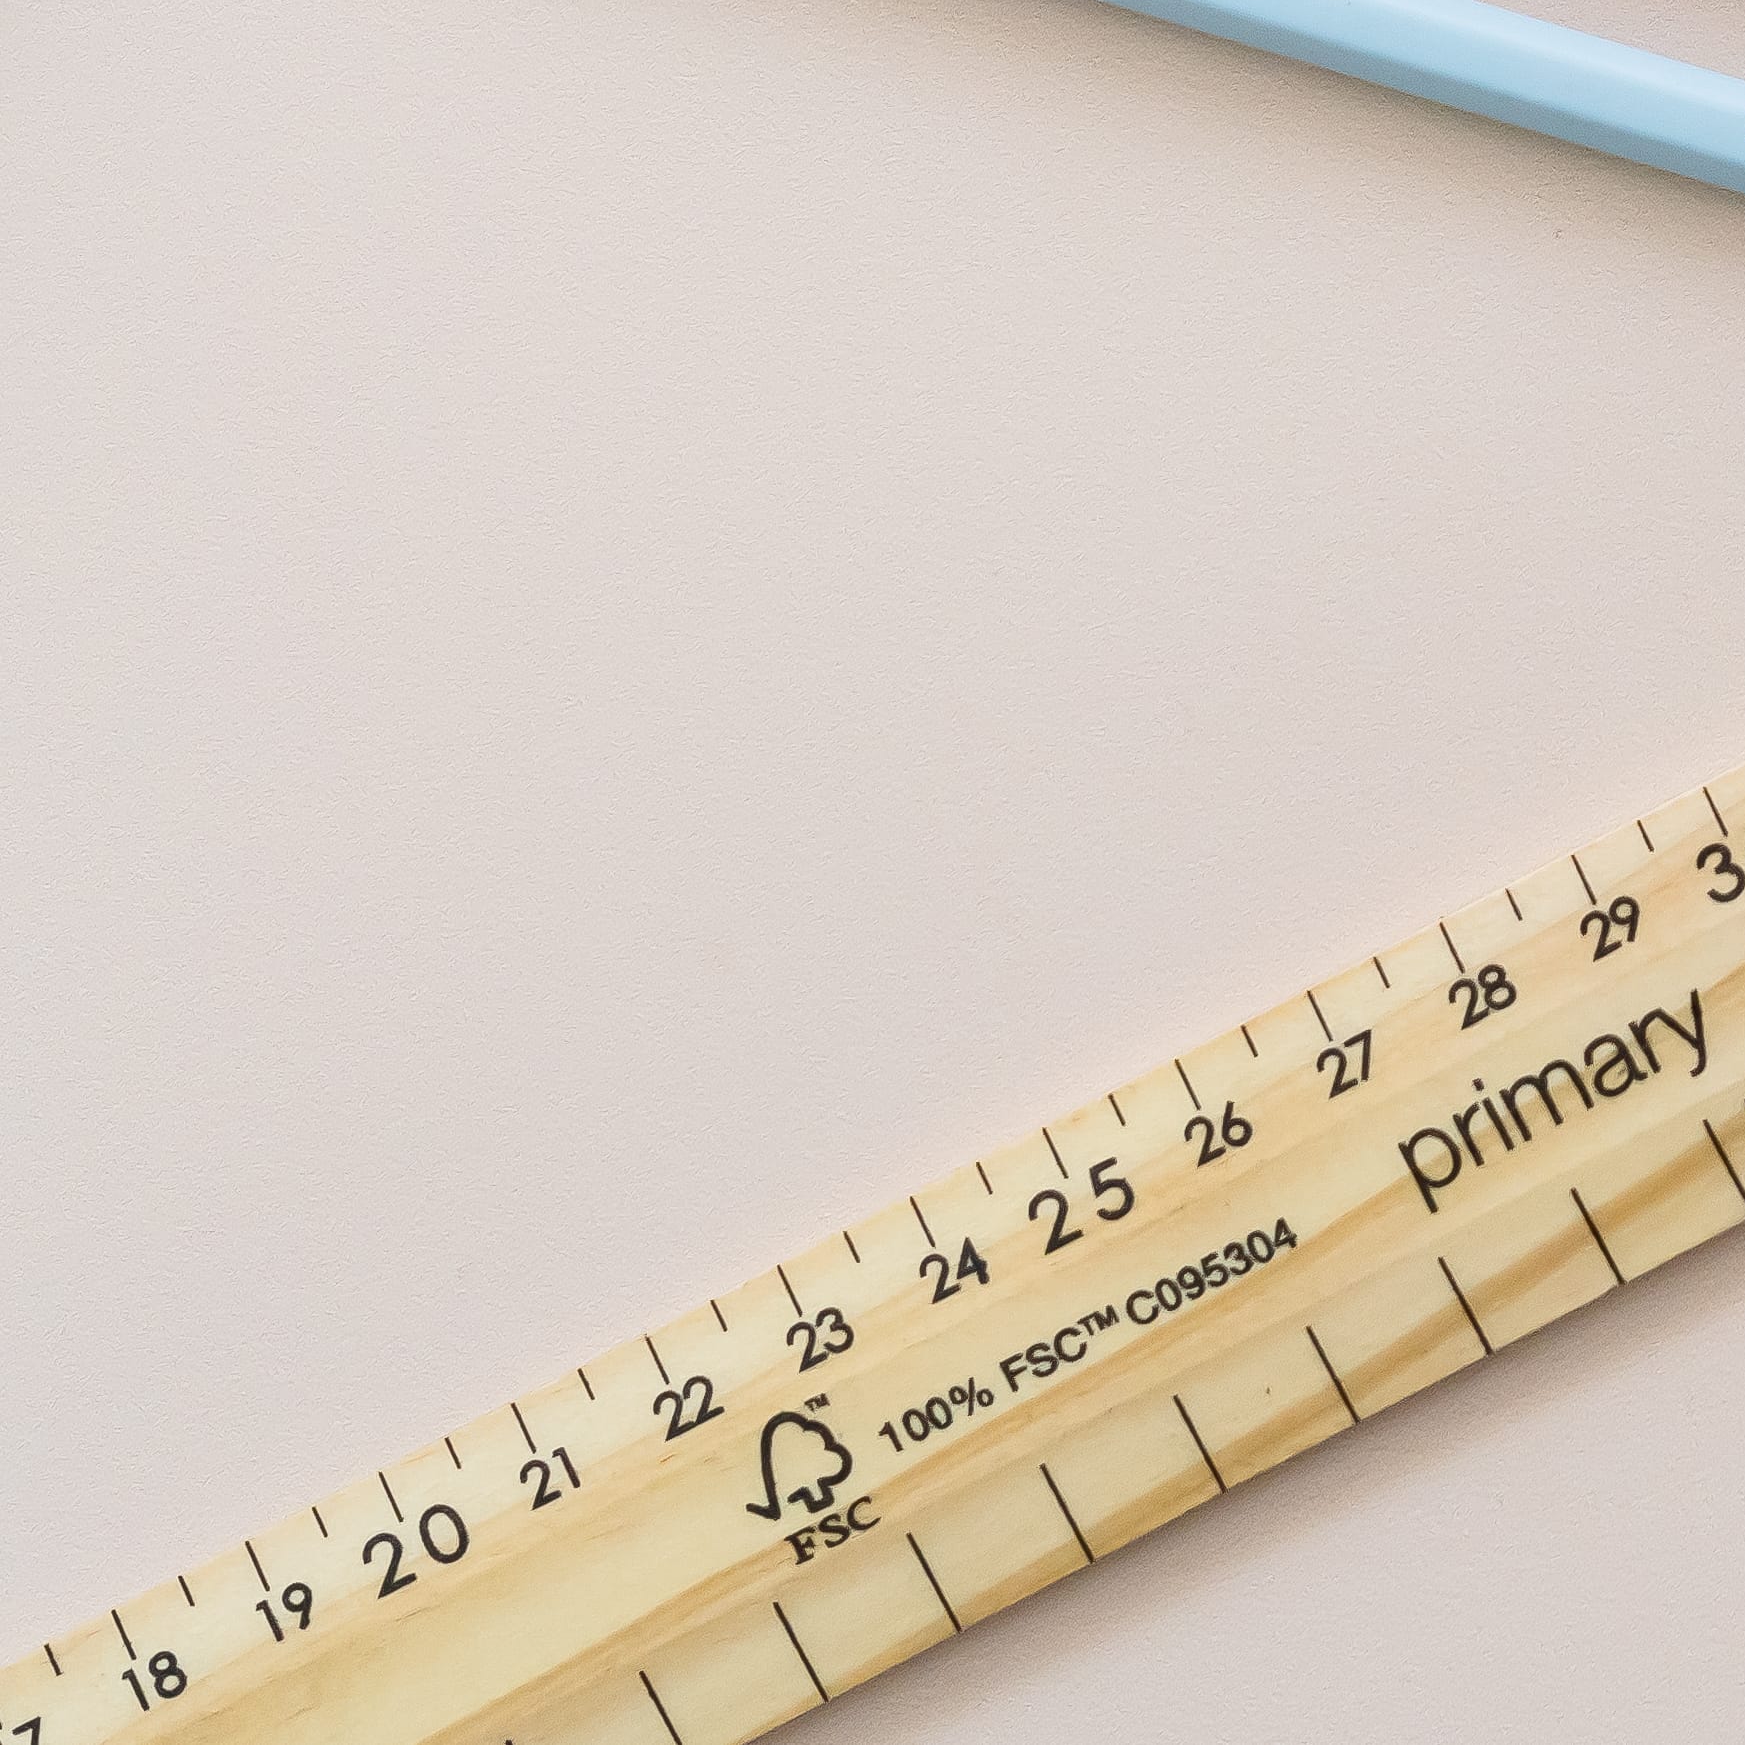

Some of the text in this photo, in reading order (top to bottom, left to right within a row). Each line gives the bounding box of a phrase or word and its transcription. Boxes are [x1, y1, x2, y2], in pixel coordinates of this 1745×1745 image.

[1398, 988, 1707, 1215] primary
[0, 1716, 42, 1745] 7
[121, 1651, 188, 1712] 18
[255, 1582, 313, 1642] 19
[362, 1504, 470, 1600] 20
[519, 1446, 581, 1511] 21
[652, 1375, 725, 1442] 22
[786, 1307, 855, 1374] 23
[919, 1237, 990, 1305] 24
[1028, 1157, 1135, 1256] 25
[1184, 1100, 1253, 1168] 26
[1316, 1029, 1372, 1099] 27
[1448, 964, 1517, 1031] 28
[1579, 895, 1641, 963] 29
[878, 1376, 995, 1453] 100%
[1125, 1218, 1298, 1325] C095304
[783, 1495, 882, 1566] FSC
